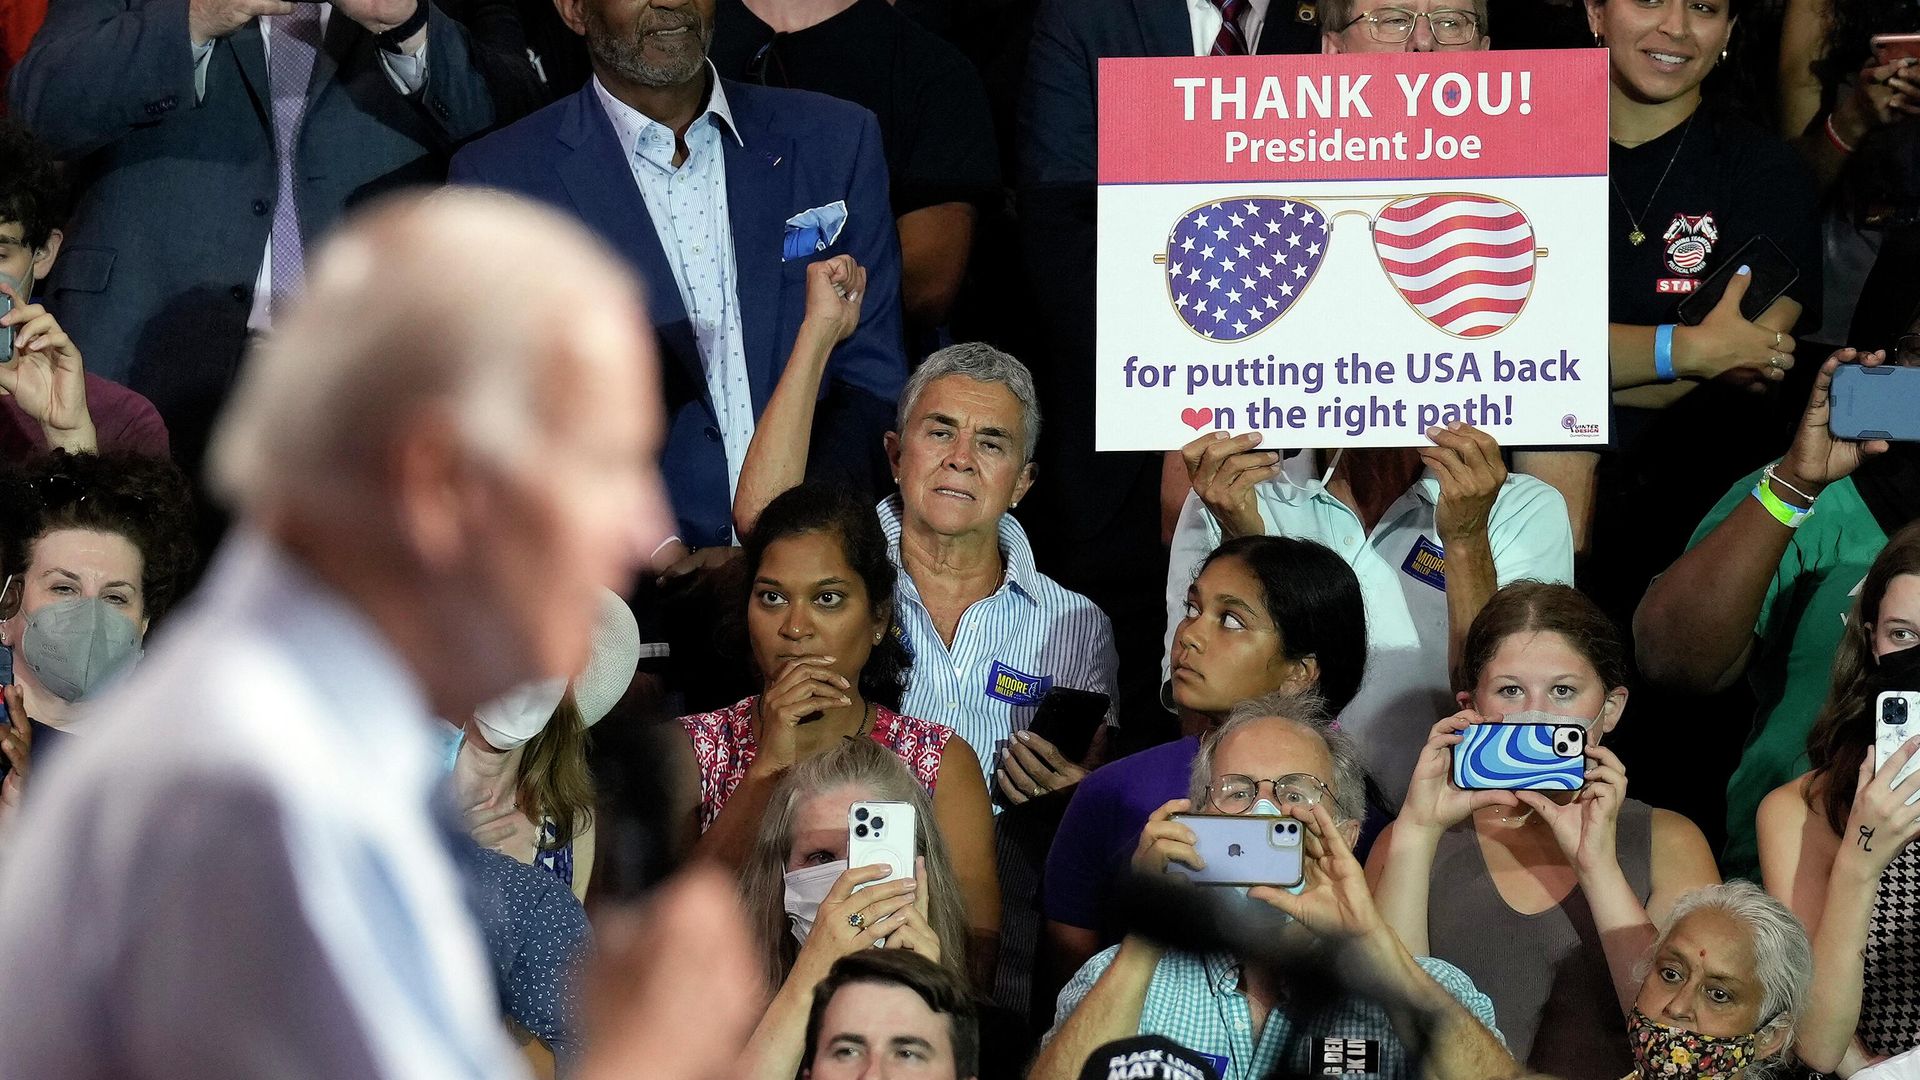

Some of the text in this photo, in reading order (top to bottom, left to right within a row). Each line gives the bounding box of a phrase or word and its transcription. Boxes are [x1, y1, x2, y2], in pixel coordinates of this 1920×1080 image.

[1173, 71, 1532, 121] THANK YOU!
[1225, 128, 1482, 163] President Joe
[1123, 349, 1580, 396] for putting the USA back
[1246, 397, 1307, 429] the
[1317, 395, 1407, 437] right
[1417, 393, 1513, 435] path!
[994, 684, 1014, 697] MILLER
[996, 673, 1029, 694] MOORE
